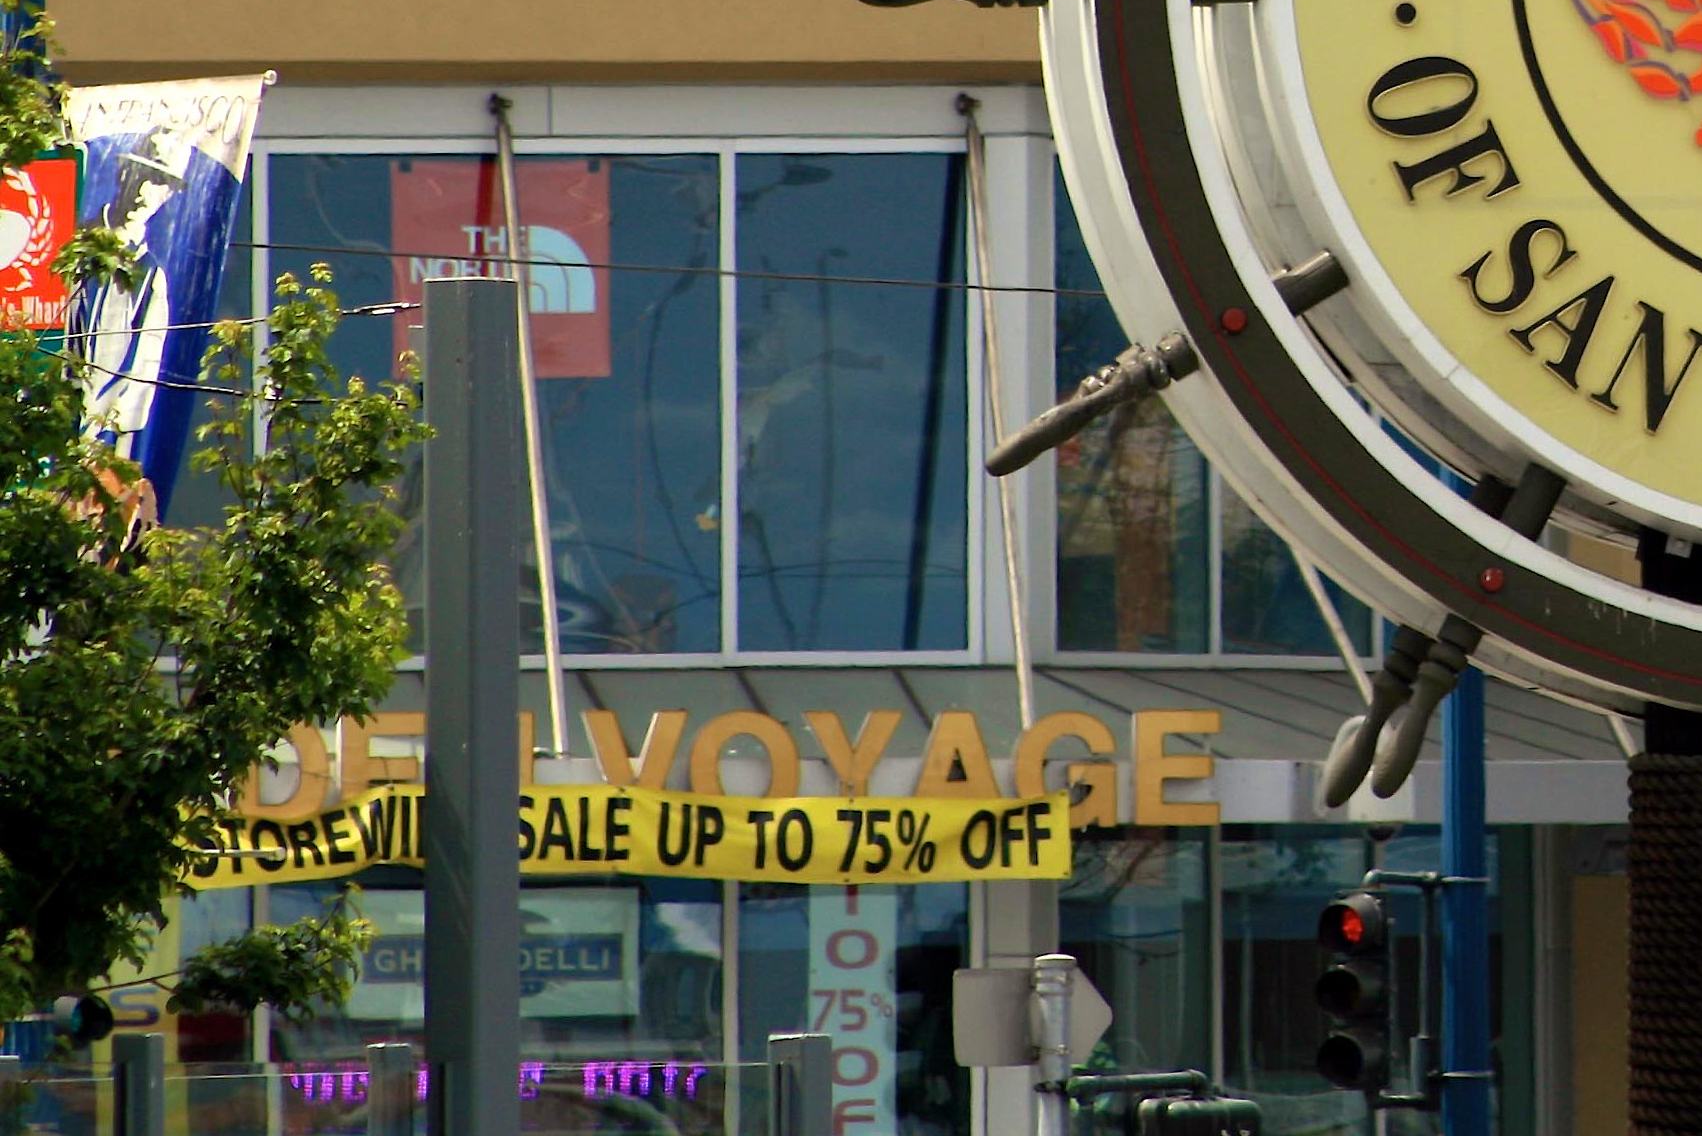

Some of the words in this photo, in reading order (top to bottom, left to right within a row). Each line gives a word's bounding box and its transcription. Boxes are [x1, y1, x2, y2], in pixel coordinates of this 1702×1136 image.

[1367, 55, 1522, 204] OF
[409, 257, 513, 285] NORT
[581, 710, 1222, 827] VOYAGE
[192, 795, 426, 878] STOREWI
[517, 795, 632, 862] SALE
[657, 801, 725, 867] UP
[747, 809, 814, 873] TO
[836, 807, 937, 875] 75%
[959, 802, 1052, 870] OFF
[812, 988, 894, 1033] 75%
